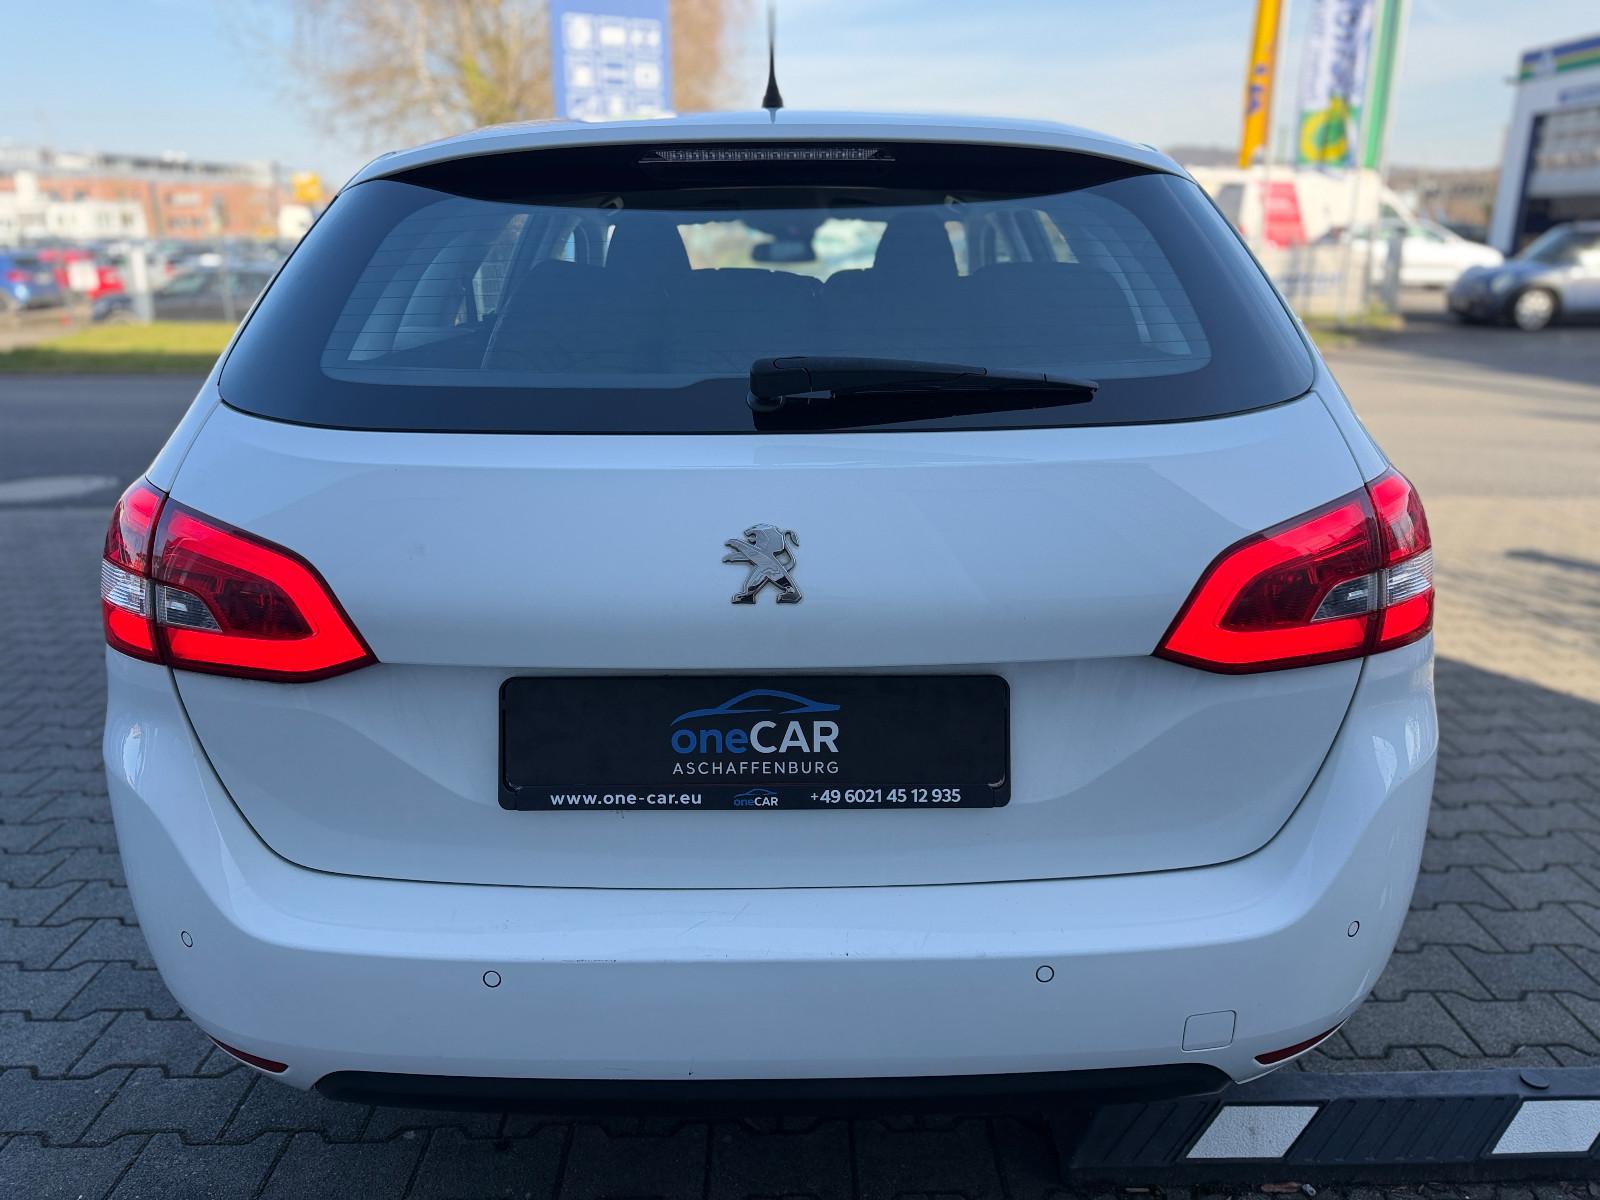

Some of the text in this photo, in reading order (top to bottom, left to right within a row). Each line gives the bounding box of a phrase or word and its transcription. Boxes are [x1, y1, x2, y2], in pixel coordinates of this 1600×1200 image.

[671, 720, 840, 754] oneCAR
[672, 761, 839, 775] ASCHAFFENBURG
[550, 793, 702, 806] www.one-car.eu
[733, 796, 779, 807] oneCAR
[810, 788, 961, 804] +49 6021 45 12 935
